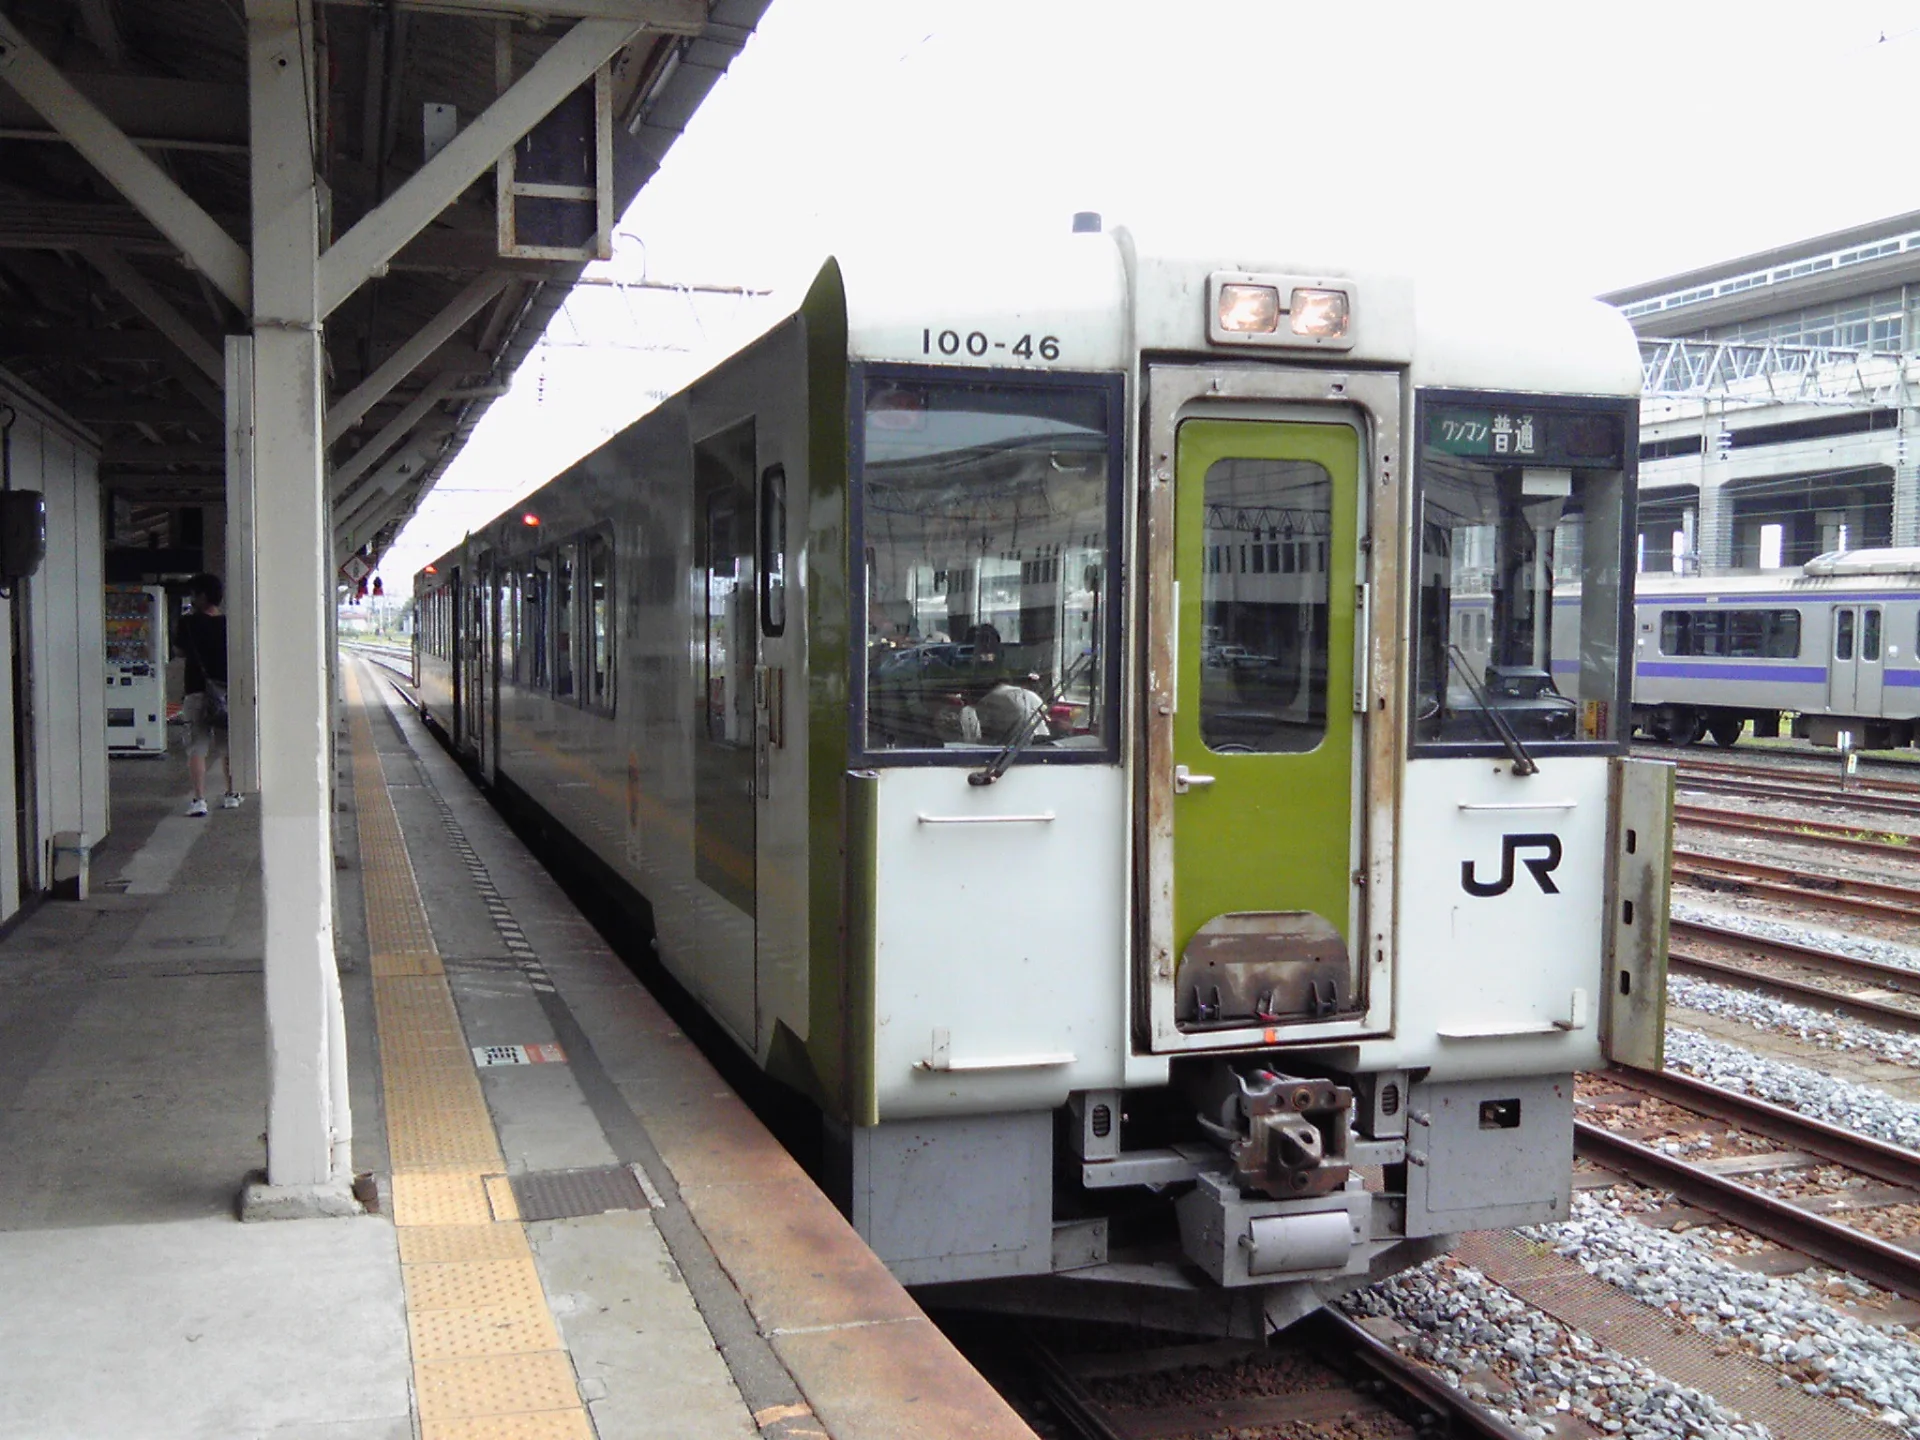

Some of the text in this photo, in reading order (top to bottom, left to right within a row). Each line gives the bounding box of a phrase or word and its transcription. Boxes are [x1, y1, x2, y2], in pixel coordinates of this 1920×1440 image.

[923, 328, 1060, 361] 100-46
[1442, 414, 1534, 454] ワンマン 普通
[1461, 833, 1561, 897] JR
